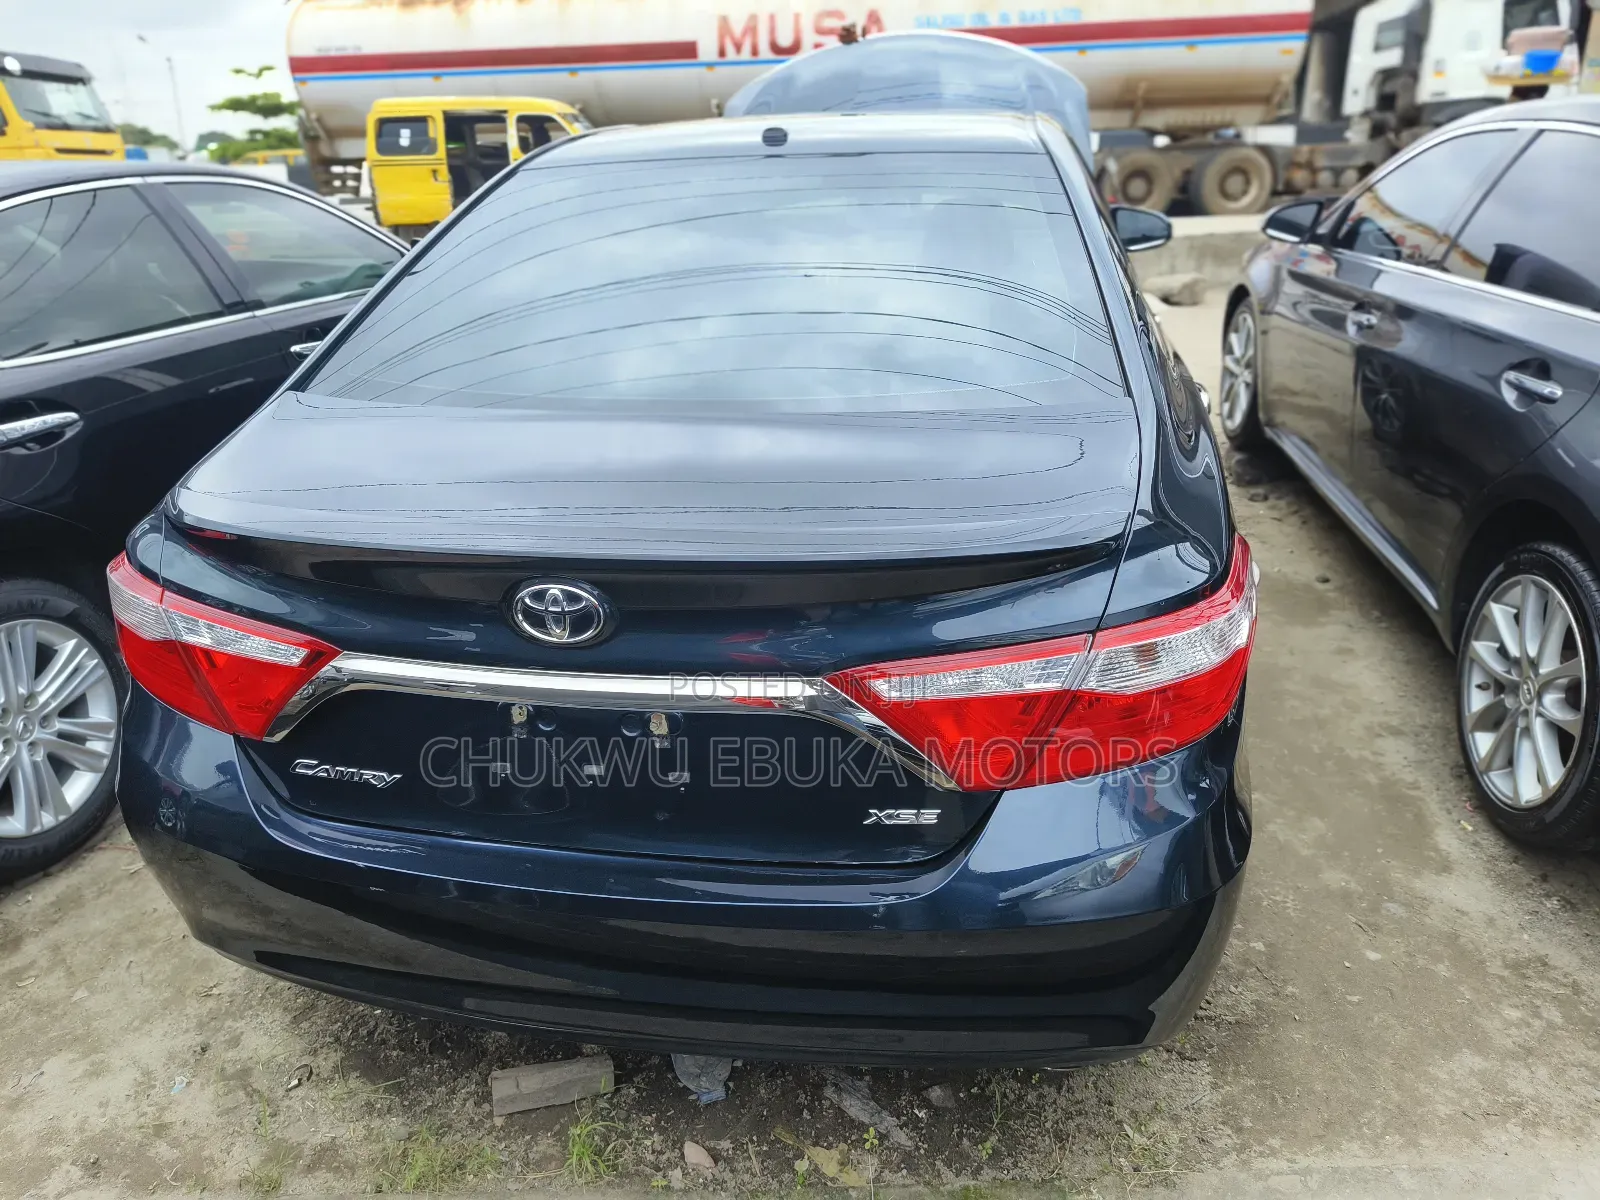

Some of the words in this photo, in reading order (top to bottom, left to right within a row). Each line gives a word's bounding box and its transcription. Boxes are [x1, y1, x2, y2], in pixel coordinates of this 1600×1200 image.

[717, 9, 886, 59] MUSA
[290, 758, 402, 788] CAMRY
[862, 808, 941, 825] XSE
